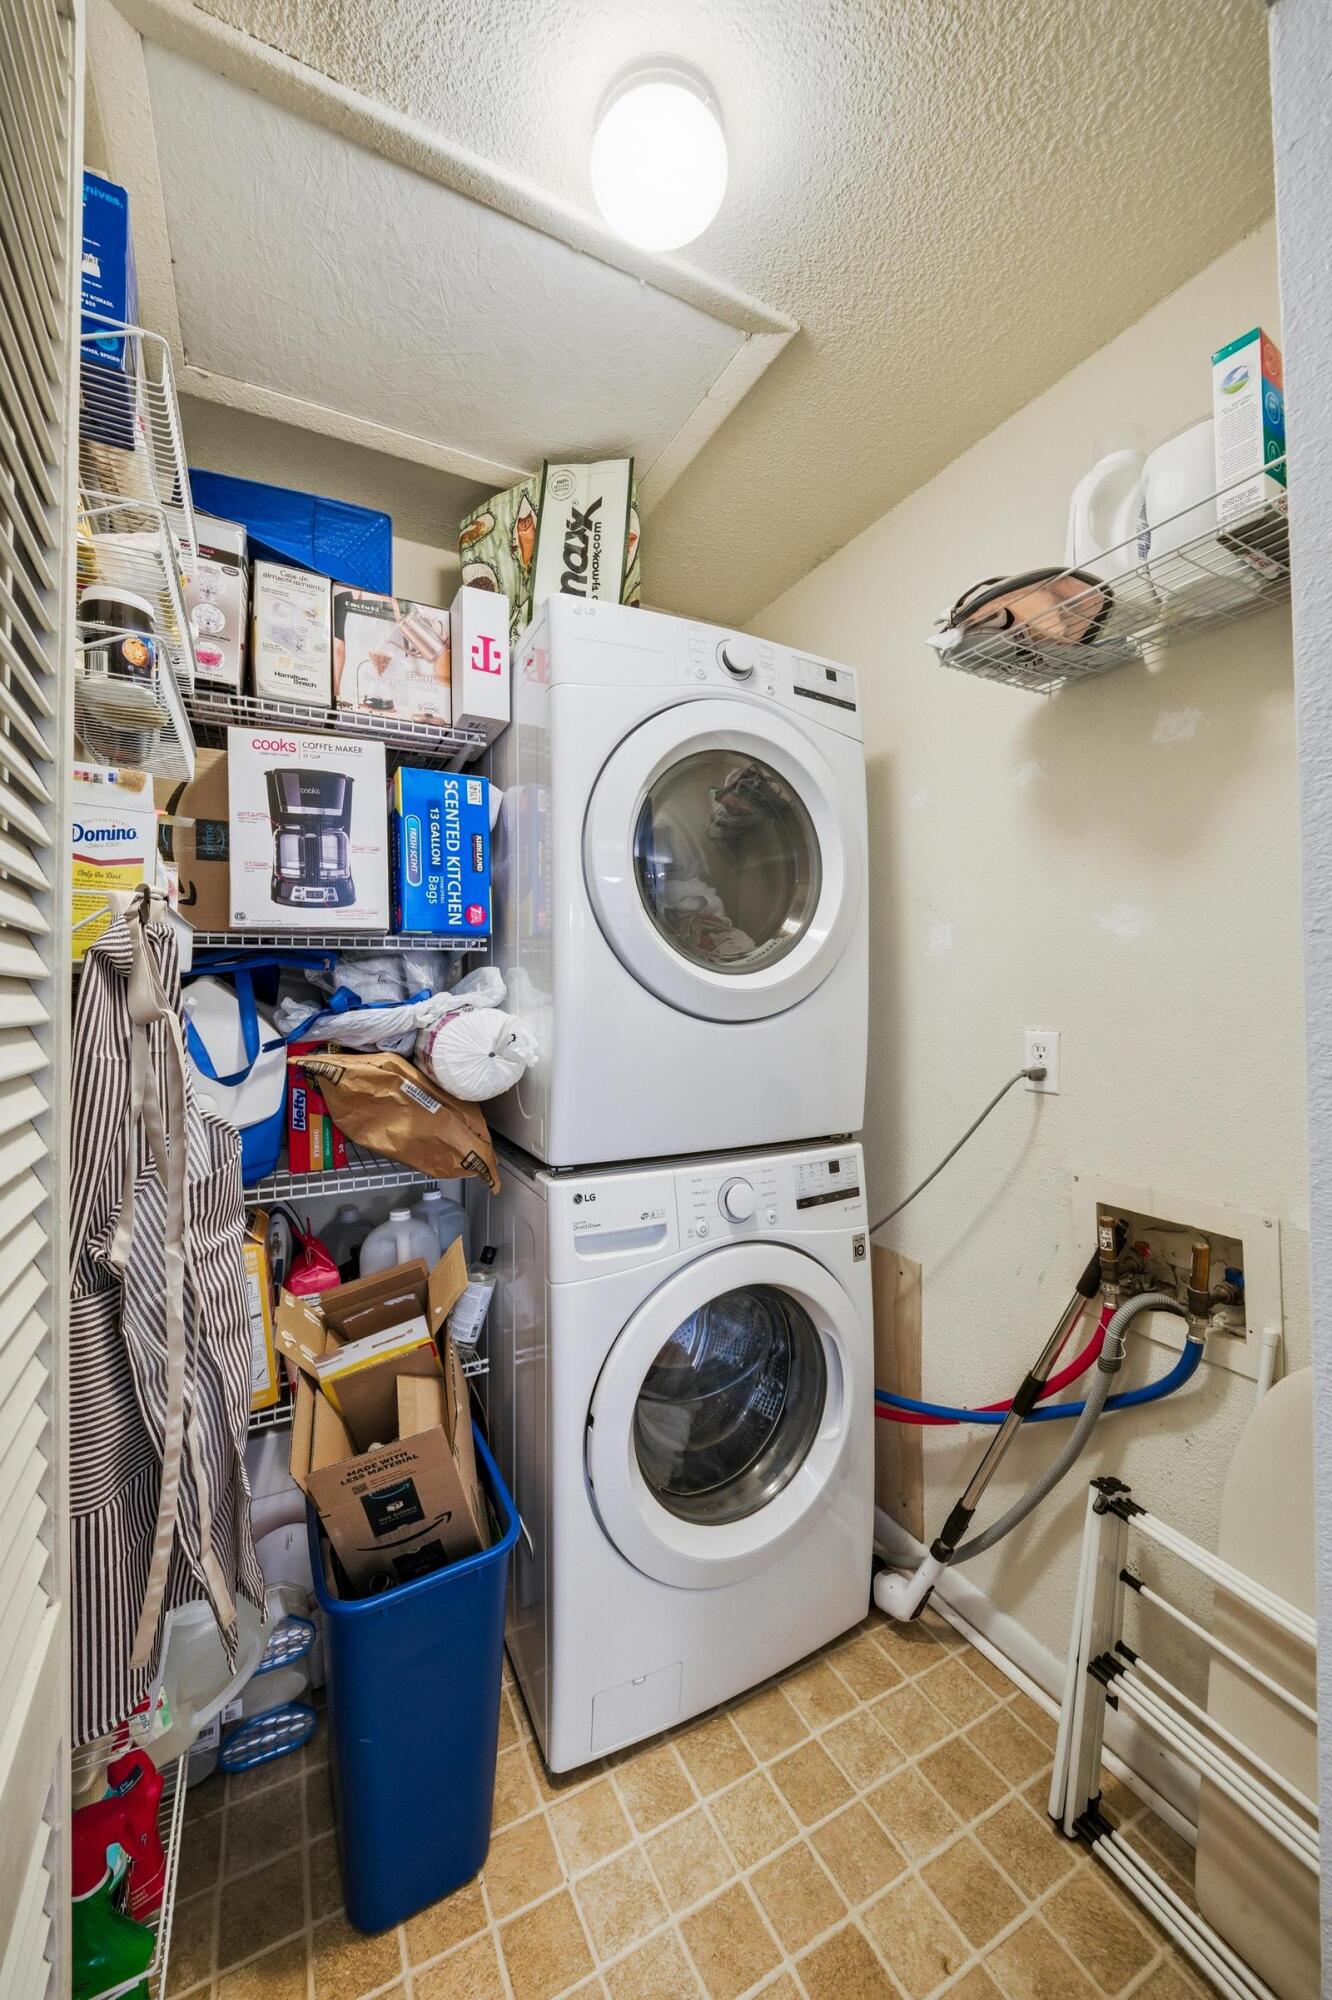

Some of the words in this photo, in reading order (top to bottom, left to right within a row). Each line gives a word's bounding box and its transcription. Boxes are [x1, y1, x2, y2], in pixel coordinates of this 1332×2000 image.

[251, 738, 297, 753] cooks
[334, 745, 363, 754] MAKER
[429, 808, 440, 820] 13
[444, 779, 461, 852] SCENTED
[72, 823, 137, 843] Domino
[430, 823, 441, 866] GALLON
[410, 849, 418, 874] SCENT
[425, 875, 439, 905] Bags
[446, 856, 463, 926] KITCHEN
[293, 1089, 306, 1130] Hefty
[584, 1193, 597, 1202] LG
[340, 1473, 366, 1486] LESS
[367, 1454, 419, 1476] MATERIAL
[346, 1463, 379, 1477] MADE
[379, 1451, 409, 1465] WITH
